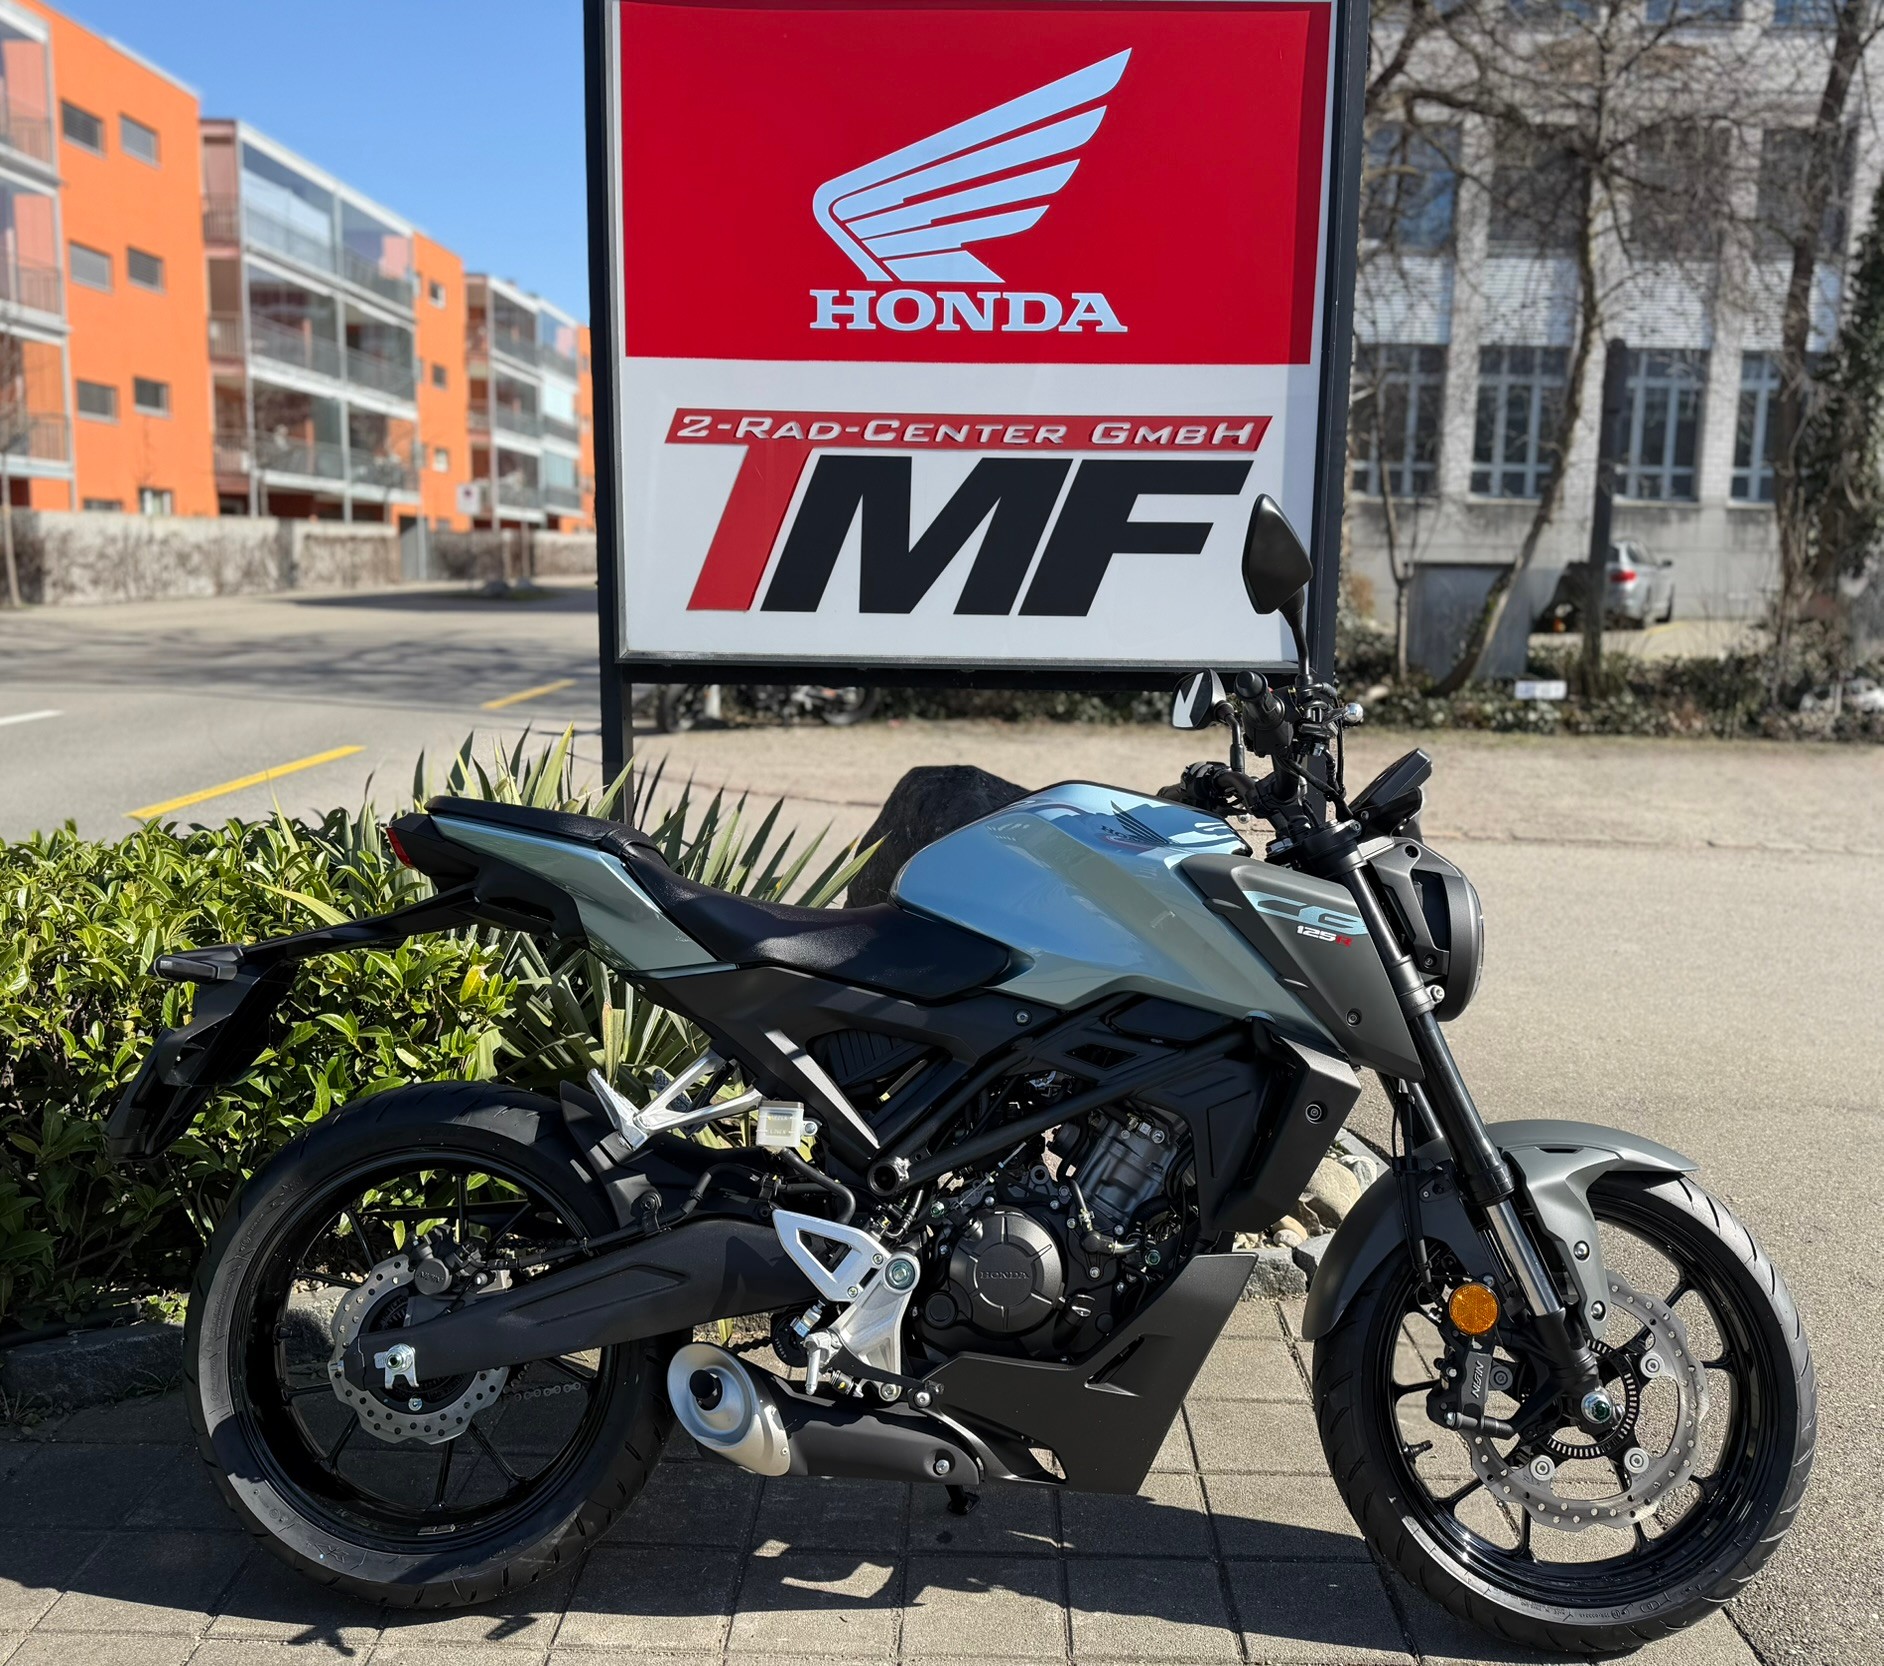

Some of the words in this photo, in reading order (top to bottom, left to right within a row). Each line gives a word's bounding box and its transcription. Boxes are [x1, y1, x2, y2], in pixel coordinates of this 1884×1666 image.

[810, 288, 1129, 333] HONDA
[665, 408, 1273, 617] TMF
[1296, 925, 1353, 948] 125R
[980, 1271, 1030, 1280] HONDA
